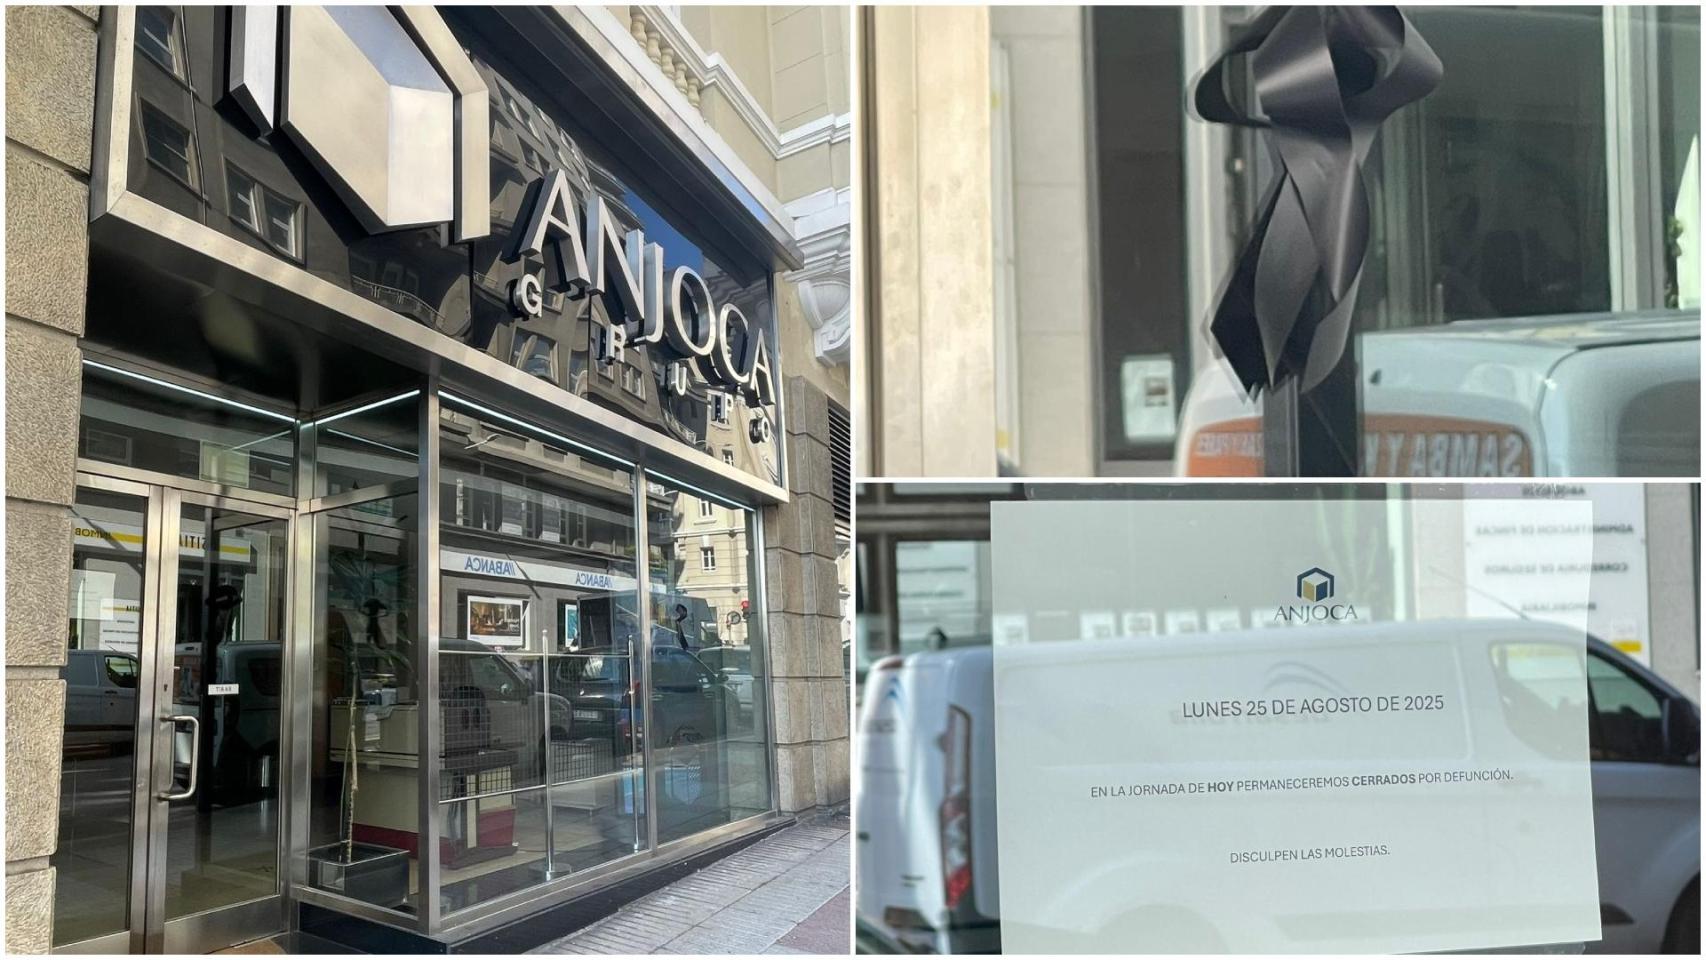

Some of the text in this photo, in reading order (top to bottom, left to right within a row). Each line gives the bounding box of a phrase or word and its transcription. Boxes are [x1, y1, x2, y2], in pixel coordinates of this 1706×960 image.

[526, 168, 776, 406] ANJOCA
[514, 273, 770, 443] GRUPO
[1275, 605, 1357, 622] ANJOCA
[1184, 701, 1242, 717] LUNES
[1247, 701, 1267, 715] 25
[1272, 699, 1295, 715] DE
[1300, 697, 1371, 714] AGOSTO
[1378, 696, 1399, 711] DE
[1405, 695, 1443, 710] 2025
[1092, 768, 1513, 797] EN LA JORNADA DE HOY PERMANECEREMOS CERRADOS POR DEFUNCIÓN.
[1231, 845, 1390, 863] DISCULPEN LAS MOLESTIAS.
